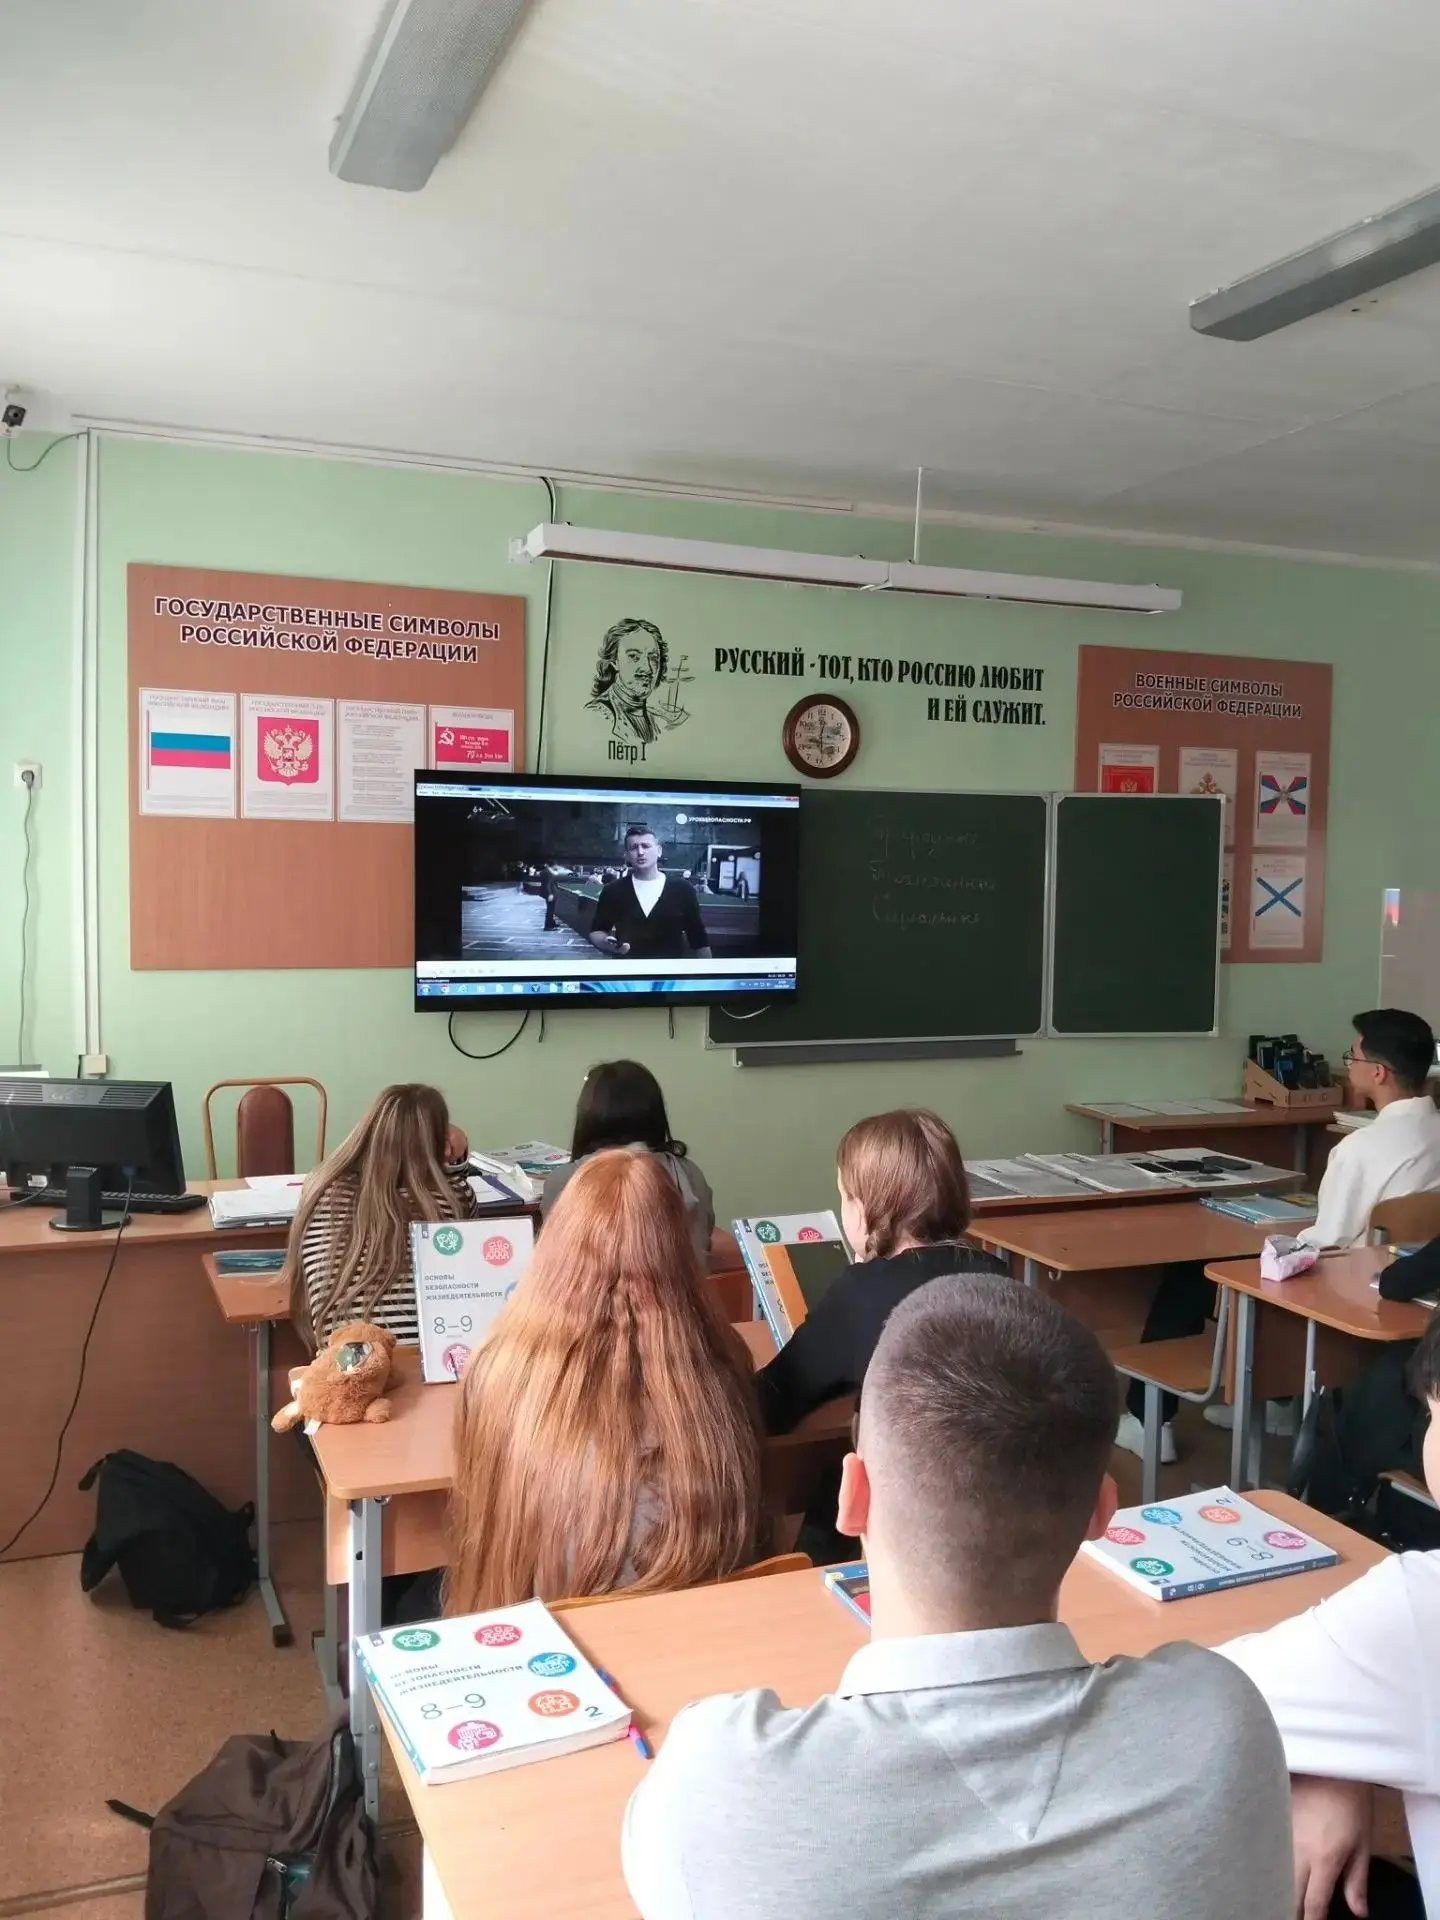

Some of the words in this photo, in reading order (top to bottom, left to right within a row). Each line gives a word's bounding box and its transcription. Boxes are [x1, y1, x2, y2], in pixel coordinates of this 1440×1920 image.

[154, 597, 383, 631] ГОСУДАРСТВЕННЫЕ
[389, 615, 500, 641] СИМВОЛЫ
[180, 624, 338, 654] РОССИЙСКОЙ
[345, 638, 478, 665] ФЕДЕРАЦИИ
[714, 647, 804, 677] РУССКИЙ
[857, 656, 893, 682] КТО
[898, 658, 976, 687] РОССИЮ
[980, 664, 1044, 692] ЛЮБИТ
[1135, 673, 1207, 692] ВОЕННЫЕ
[1210, 678, 1283, 698] СИМВОЛЫ
[927, 697, 940, 722] И
[944, 697, 967, 722] ЕЙ
[972, 700, 1046, 726] СЛУЖИТ.
[1113, 693, 1213, 713] РОССИЙСКОЙ
[1217, 700, 1303, 719] ФЕДЕРАЦИИ
[608, 739, 640, 764] Пётр
[425, 1282, 479, 1291] БЕЗОПАСНОСТИ
[425, 1291, 503, 1301] ЖИЗНЕДЕЯТЕЛЬНОСТИ
[400, 1664, 524, 1696] ЖИЗНЕДЕЯТЕЛЬНОСТИ
[583, 1705, 604, 1719] 2
